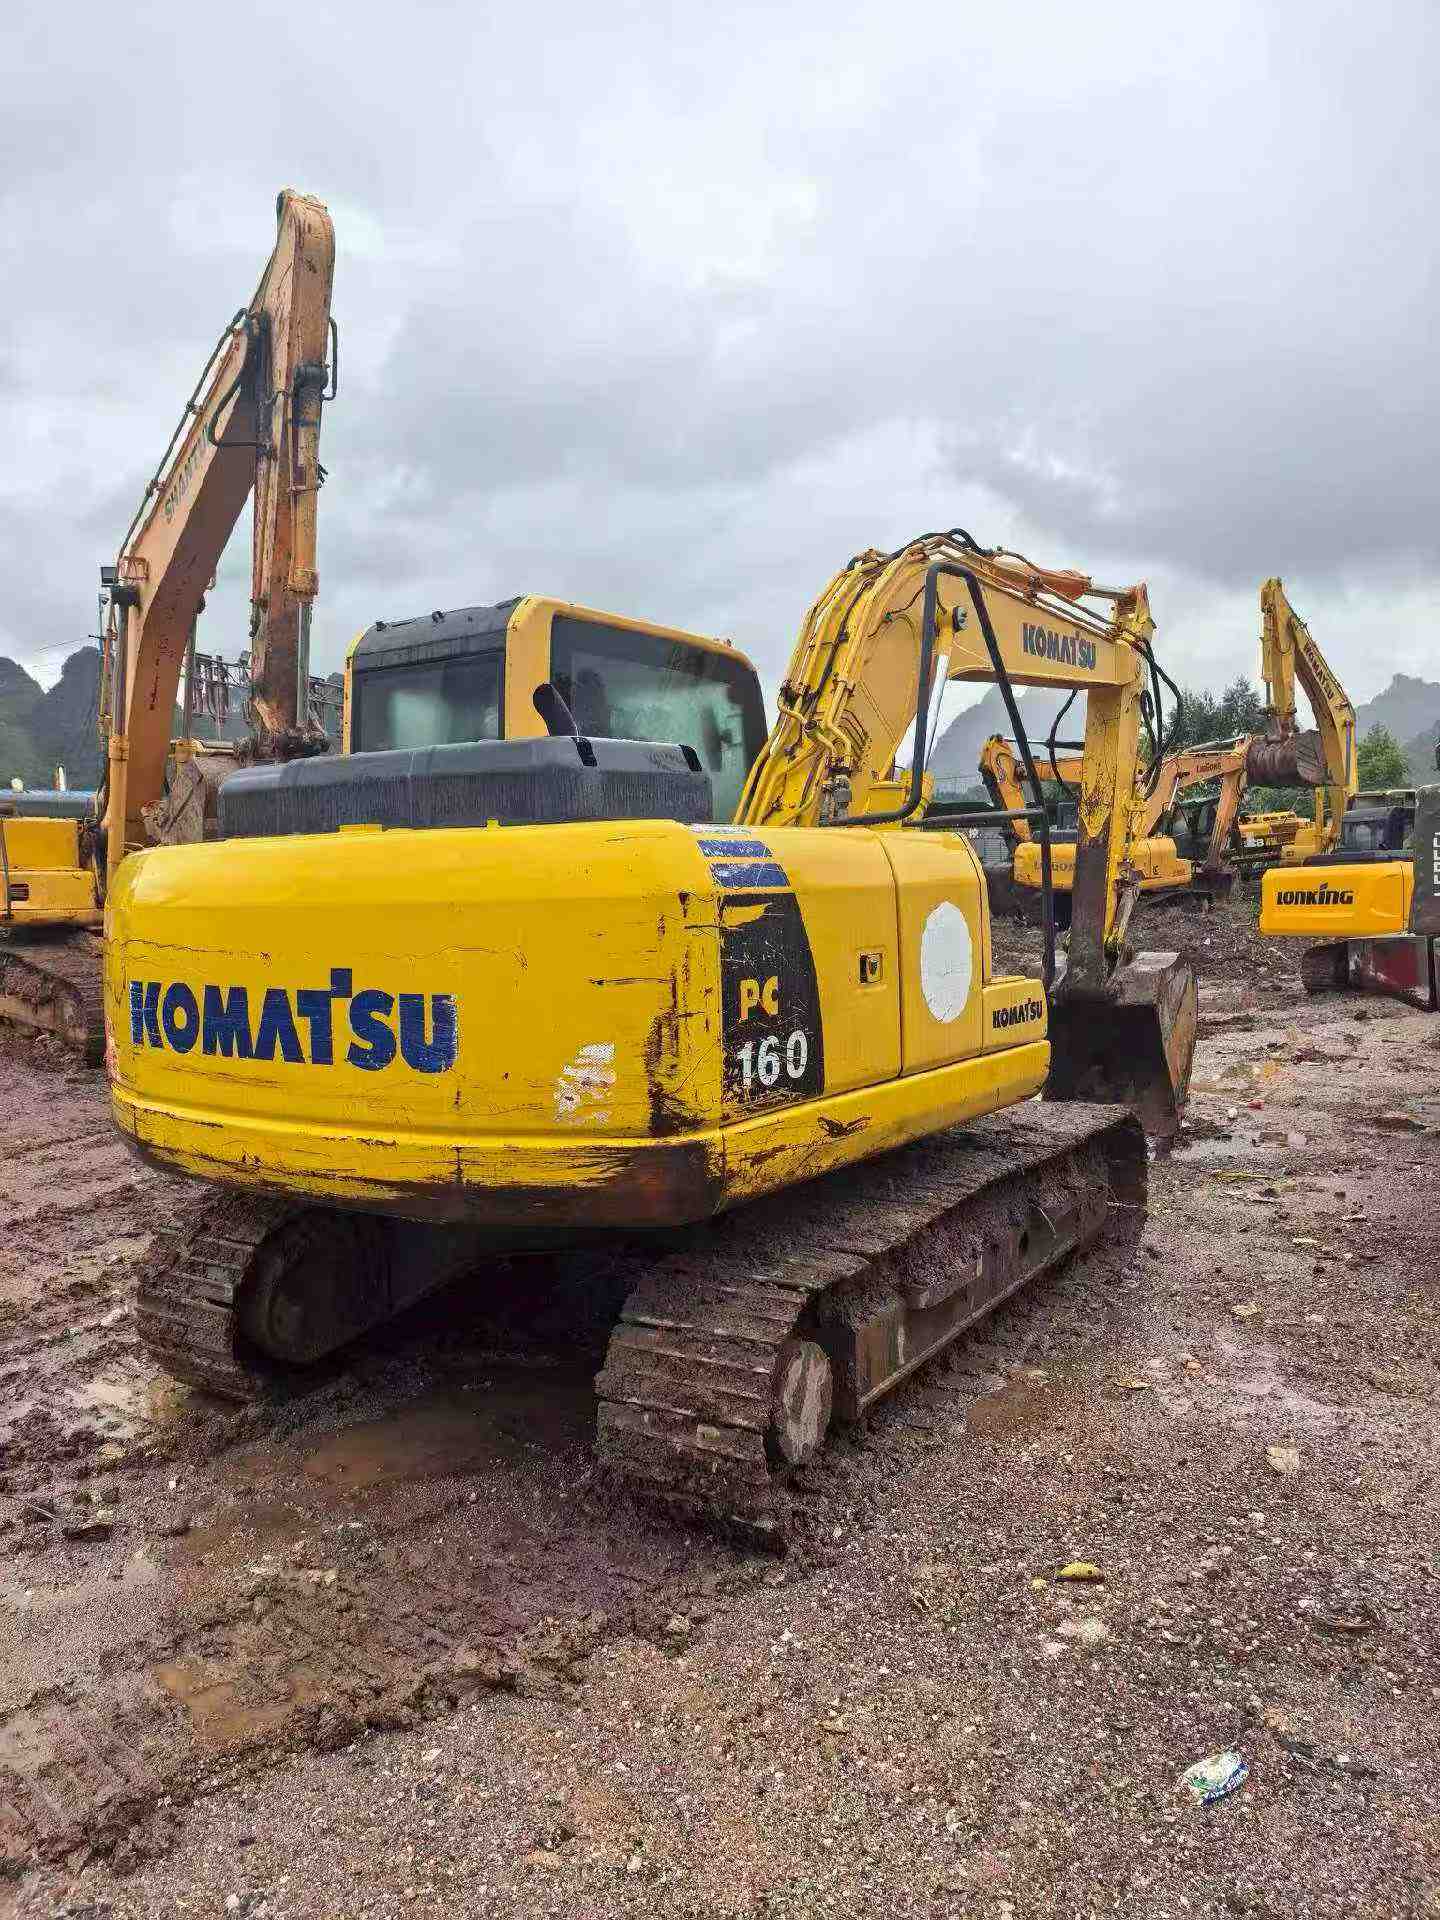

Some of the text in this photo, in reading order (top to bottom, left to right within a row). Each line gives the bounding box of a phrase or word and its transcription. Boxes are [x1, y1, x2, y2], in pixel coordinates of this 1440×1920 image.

[1023, 622, 1096, 669] KOMATSU
[129, 968, 458, 1073] KOMATSU
[740, 976, 778, 1020] PC
[992, 997, 1042, 1028] KOMATSU
[737, 1030, 808, 1087] 160
